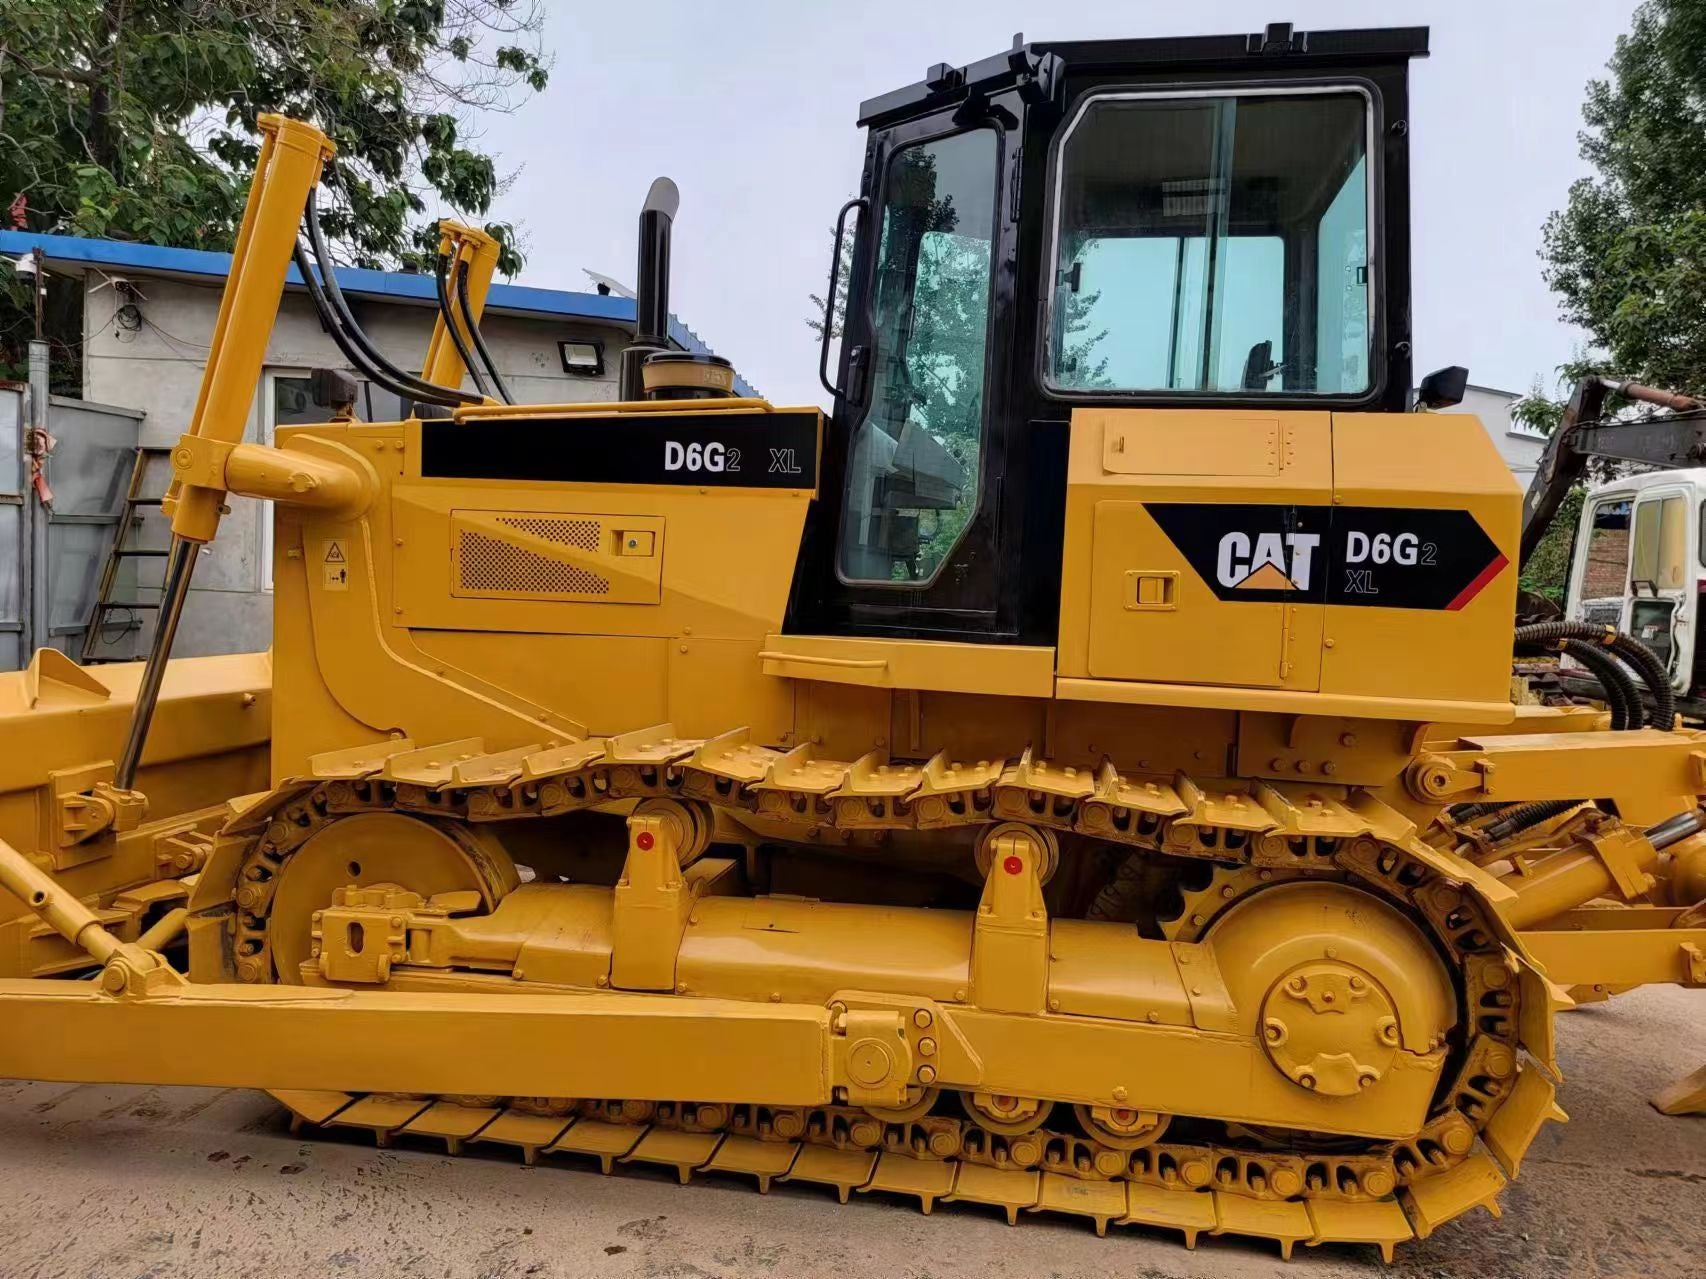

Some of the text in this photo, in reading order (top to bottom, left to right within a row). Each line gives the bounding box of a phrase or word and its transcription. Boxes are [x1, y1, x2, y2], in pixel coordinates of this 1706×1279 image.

[664, 440, 802, 474] D6G2 XL
[1216, 531, 1437, 591] CAT D6G2
[1344, 569, 1379, 594] XL
